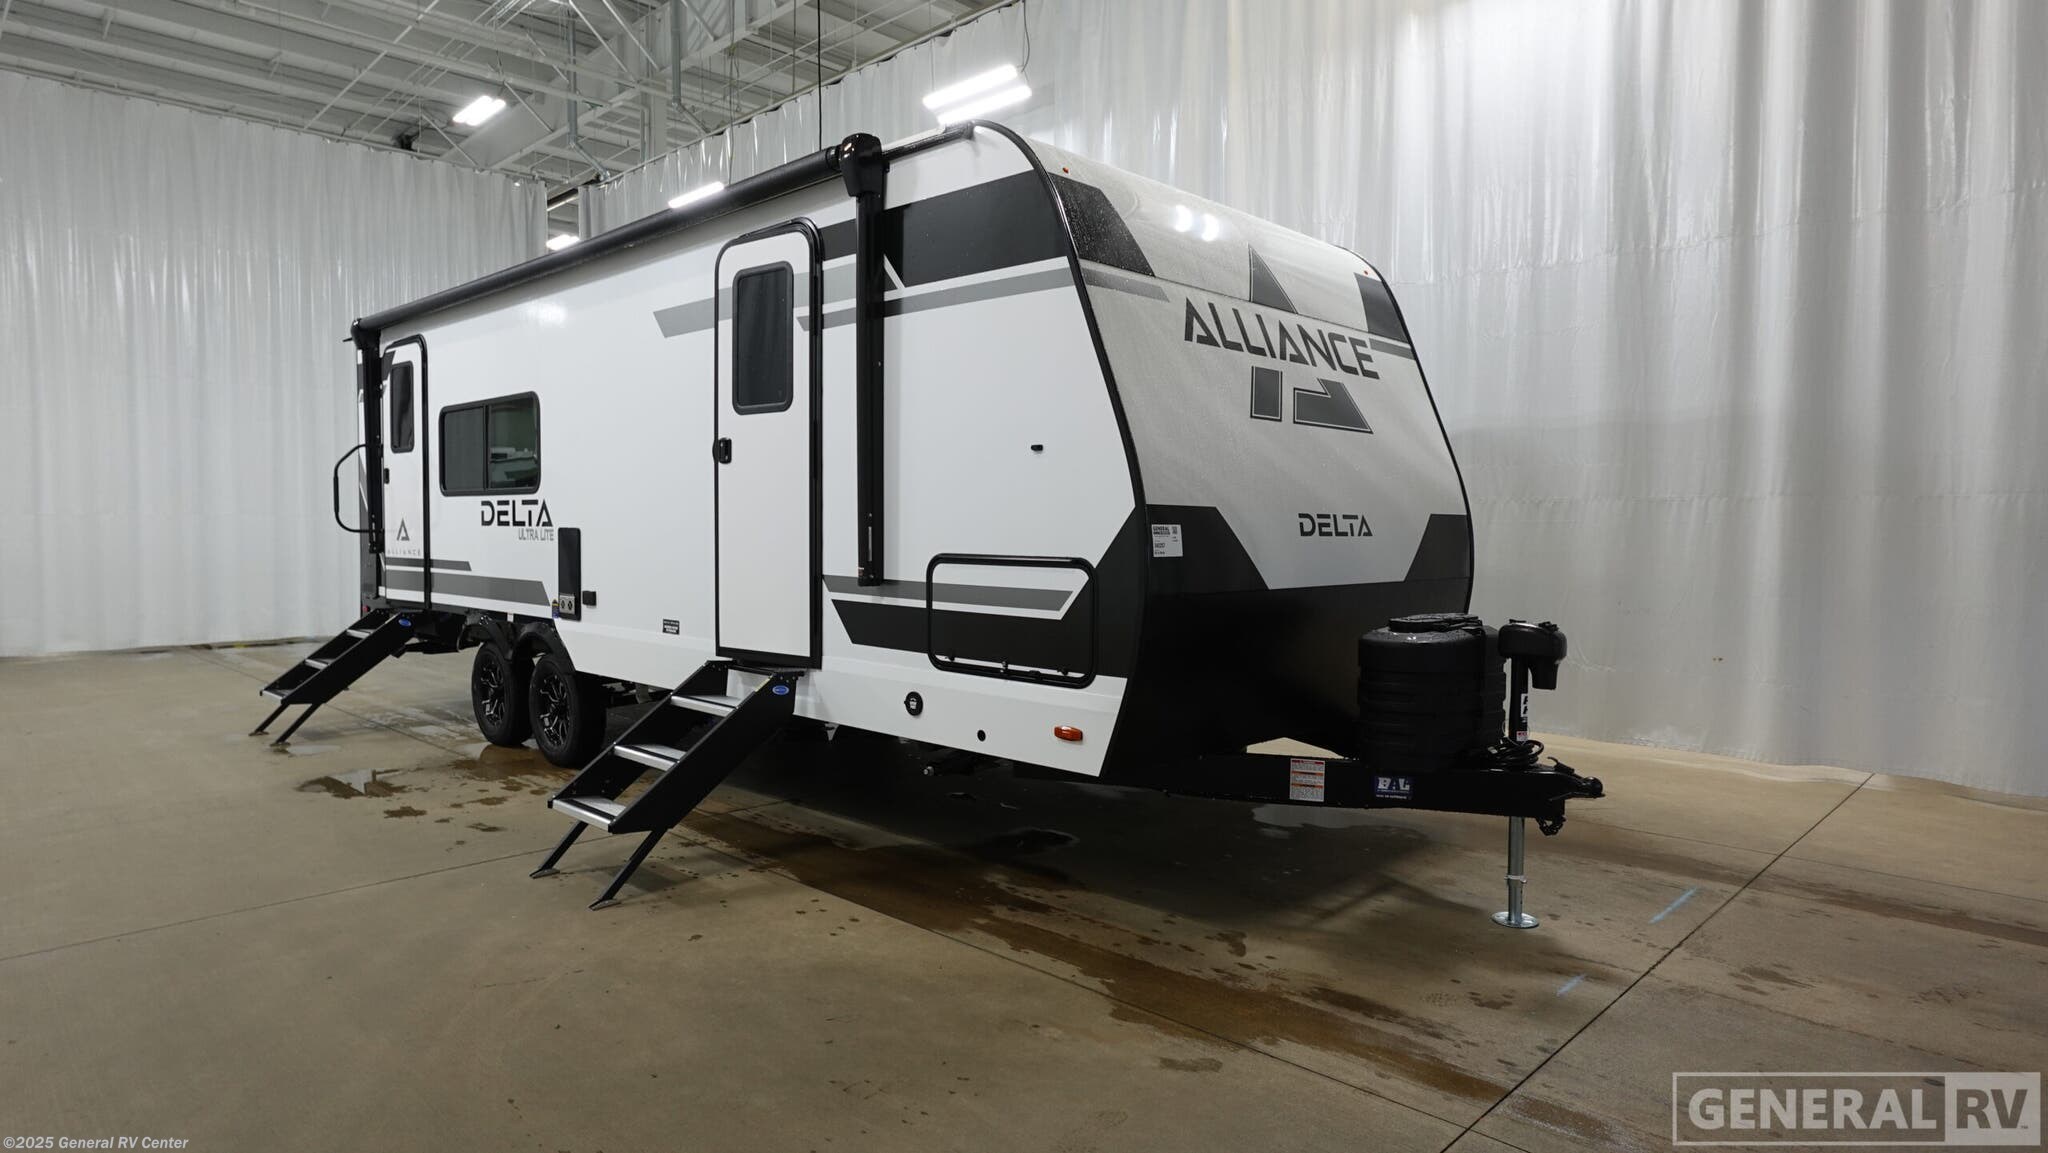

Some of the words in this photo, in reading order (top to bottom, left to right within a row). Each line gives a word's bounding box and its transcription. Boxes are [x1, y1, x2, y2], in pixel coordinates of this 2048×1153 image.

[1184, 297, 1380, 380] ALLIANCE
[481, 499, 553, 527] DELTA
[1298, 513, 1373, 537] DELTA
[518, 528, 540, 541] ULTRA
[540, 528, 555, 541] LITE
[387, 547, 421, 556] ALLIANCE
